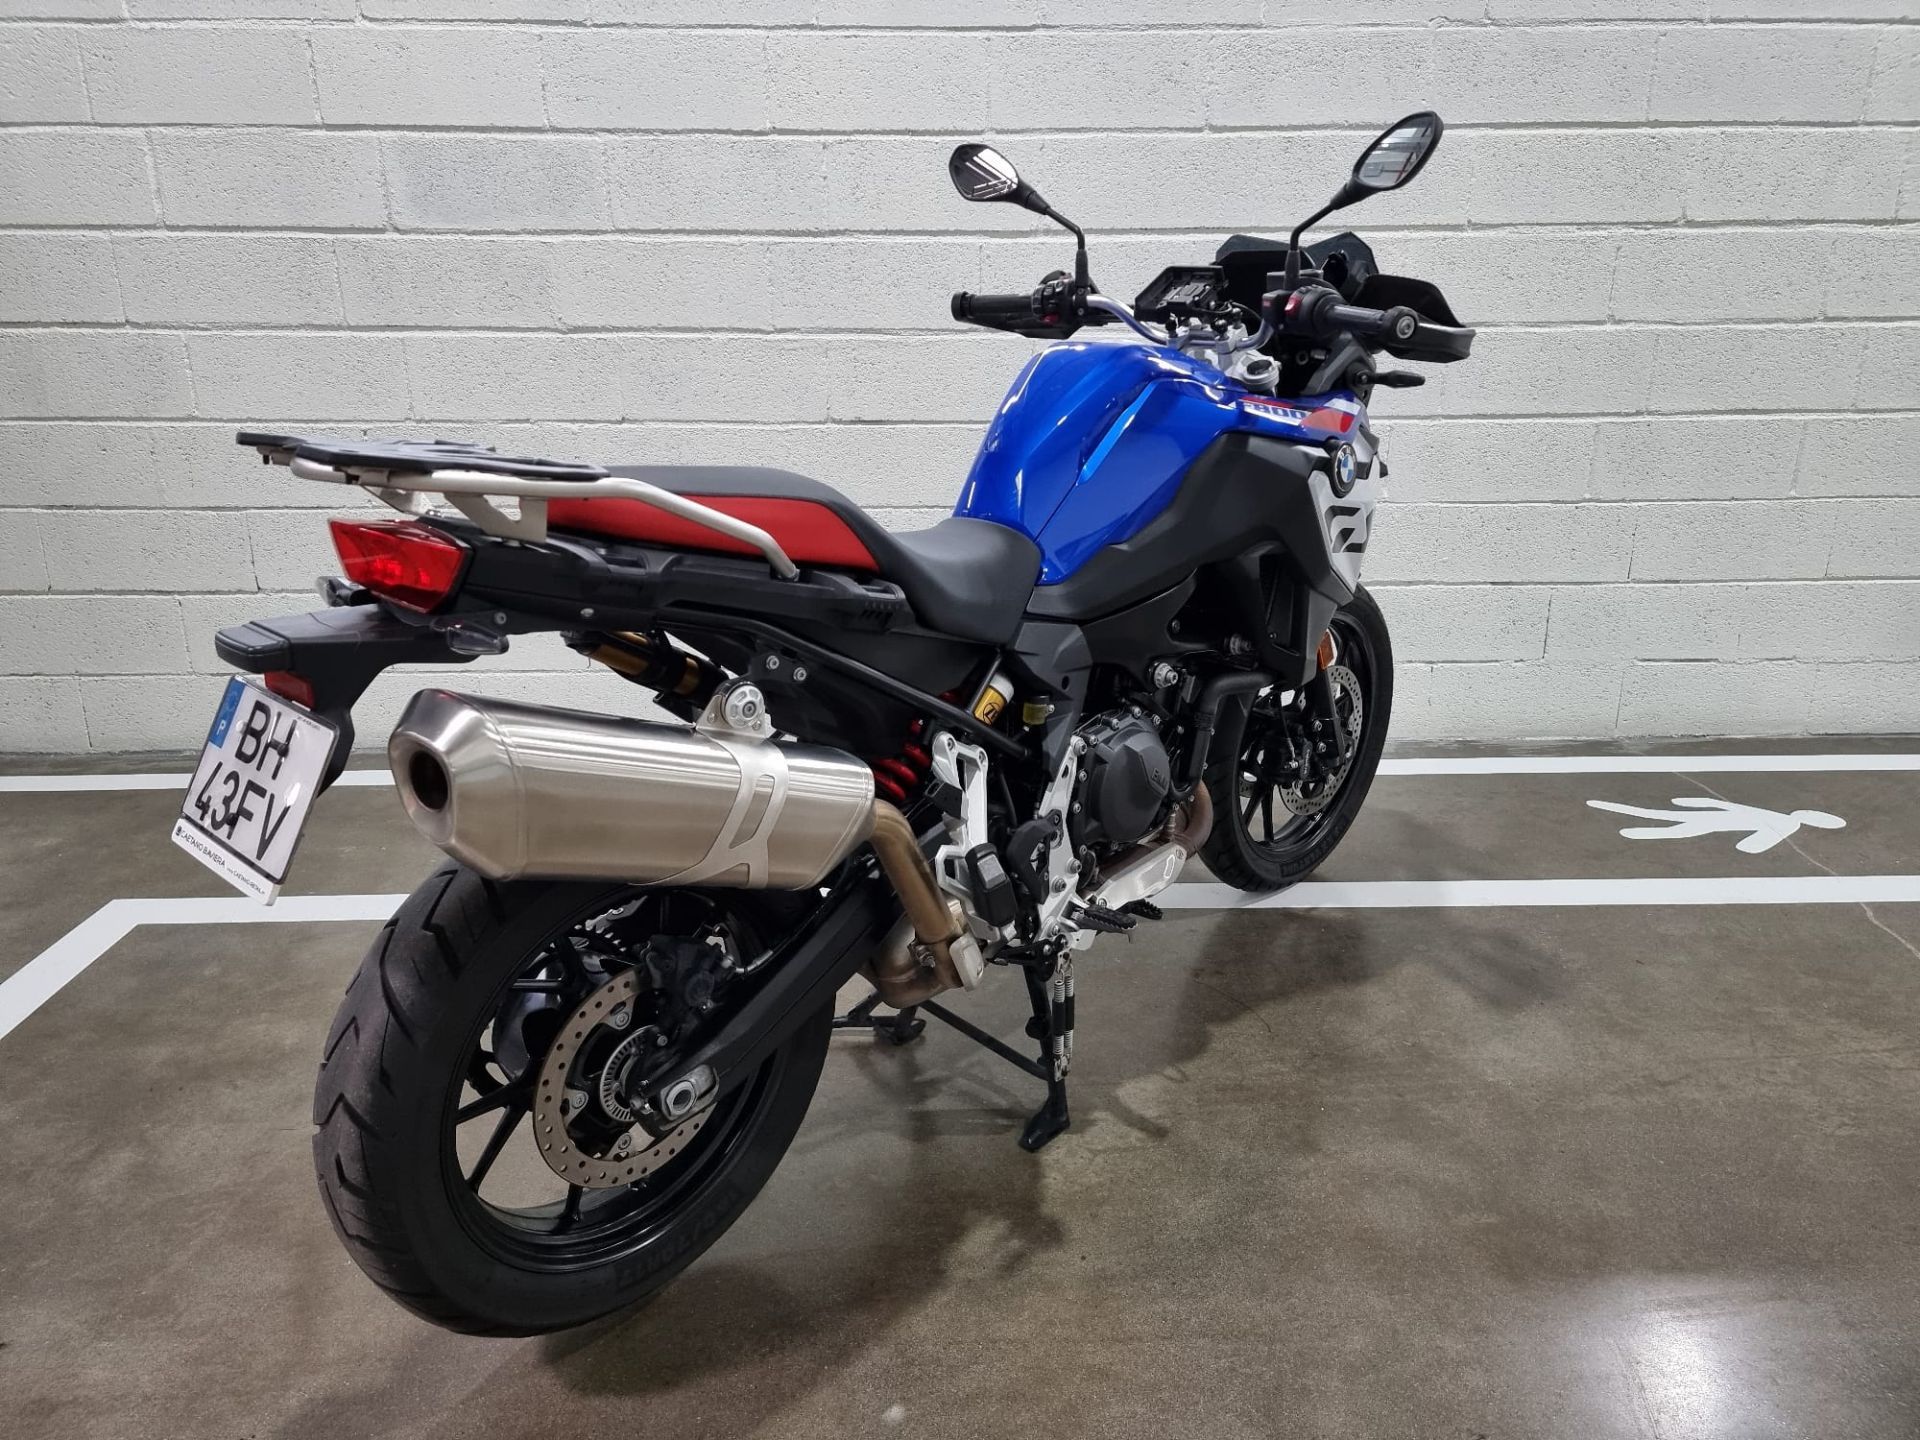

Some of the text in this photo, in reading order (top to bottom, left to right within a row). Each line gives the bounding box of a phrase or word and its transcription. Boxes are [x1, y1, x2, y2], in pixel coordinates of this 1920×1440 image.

[216, 720, 226, 734] P
[234, 700, 297, 780] BH
[195, 761, 291, 861] 43FV
